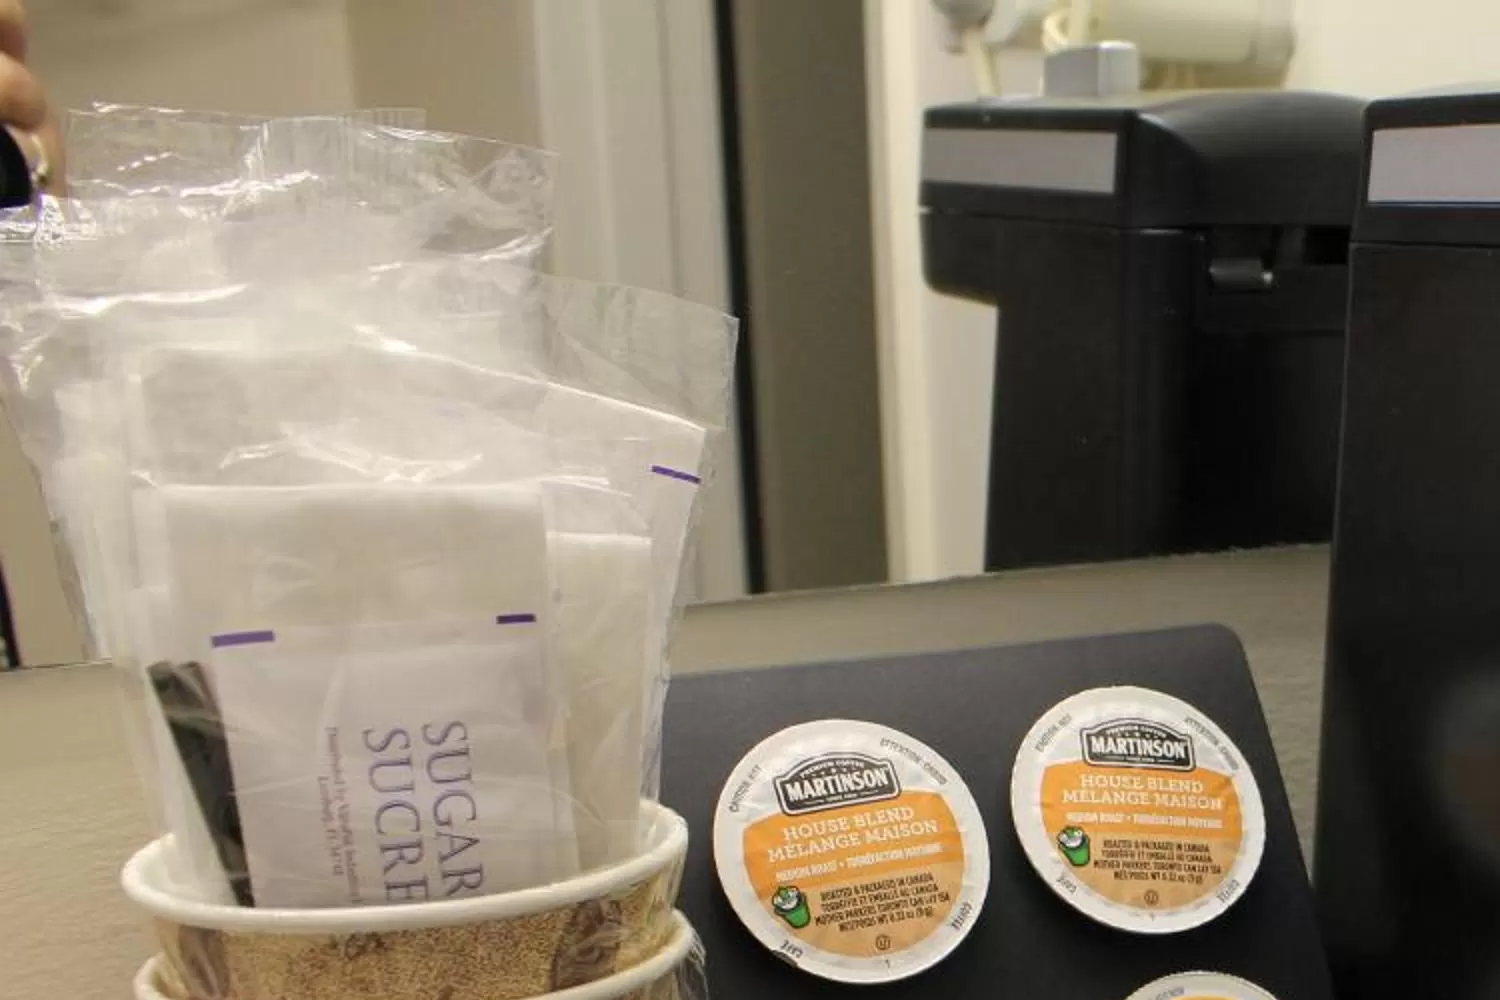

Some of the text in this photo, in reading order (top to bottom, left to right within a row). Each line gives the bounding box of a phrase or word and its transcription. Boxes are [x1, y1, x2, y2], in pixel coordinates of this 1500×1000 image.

[1090, 736, 1186, 759] MARTINSON
[785, 769, 889, 802] MARTINSON
[1080, 774, 1204, 793] HOUSE BLEND
[362, 727, 429, 901] SUCRE
[421, 720, 485, 897] SUGAR
[1154, 793, 1223, 810] MAISON
[783, 807, 915, 841] HOUSE BLEND
[865, 820, 938, 845] MAISON
